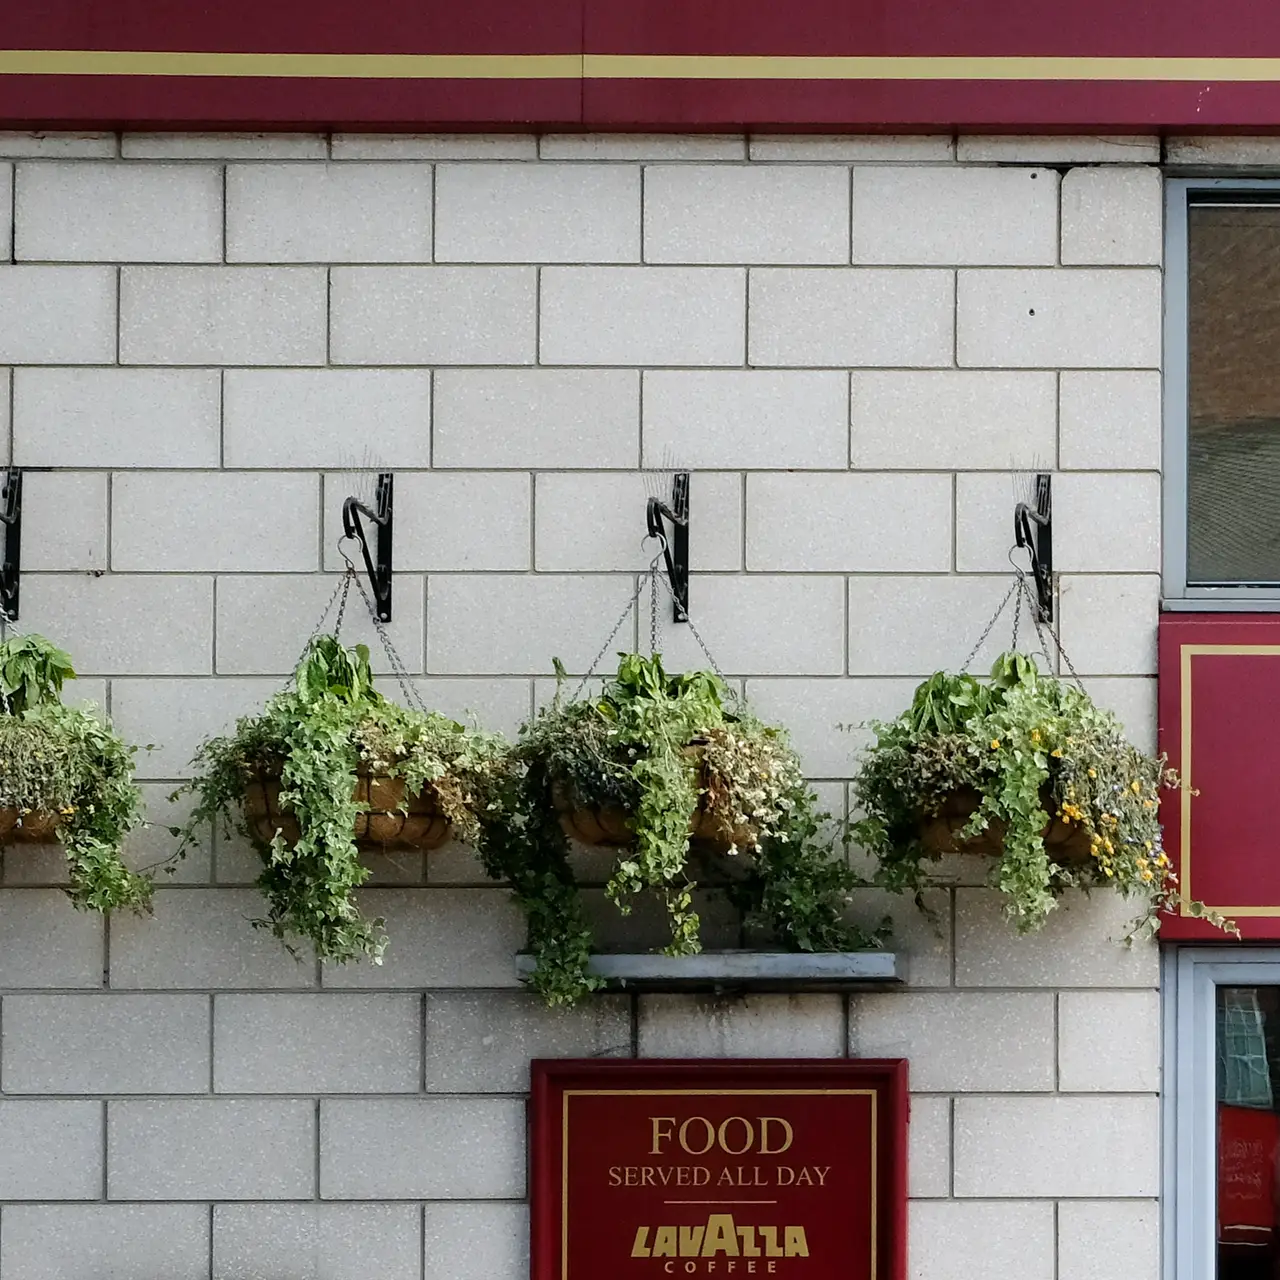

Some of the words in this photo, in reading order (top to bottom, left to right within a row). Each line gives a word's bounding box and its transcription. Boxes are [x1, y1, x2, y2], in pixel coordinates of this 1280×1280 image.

[649, 1117, 793, 1154] FOOD
[609, 1167, 710, 1186] SERVED
[717, 1167, 767, 1185] ALL
[778, 1167, 830, 1185] DAY
[631, 1214, 809, 1257] LAVAZZA
[665, 1261, 775, 1273] COFFEE
